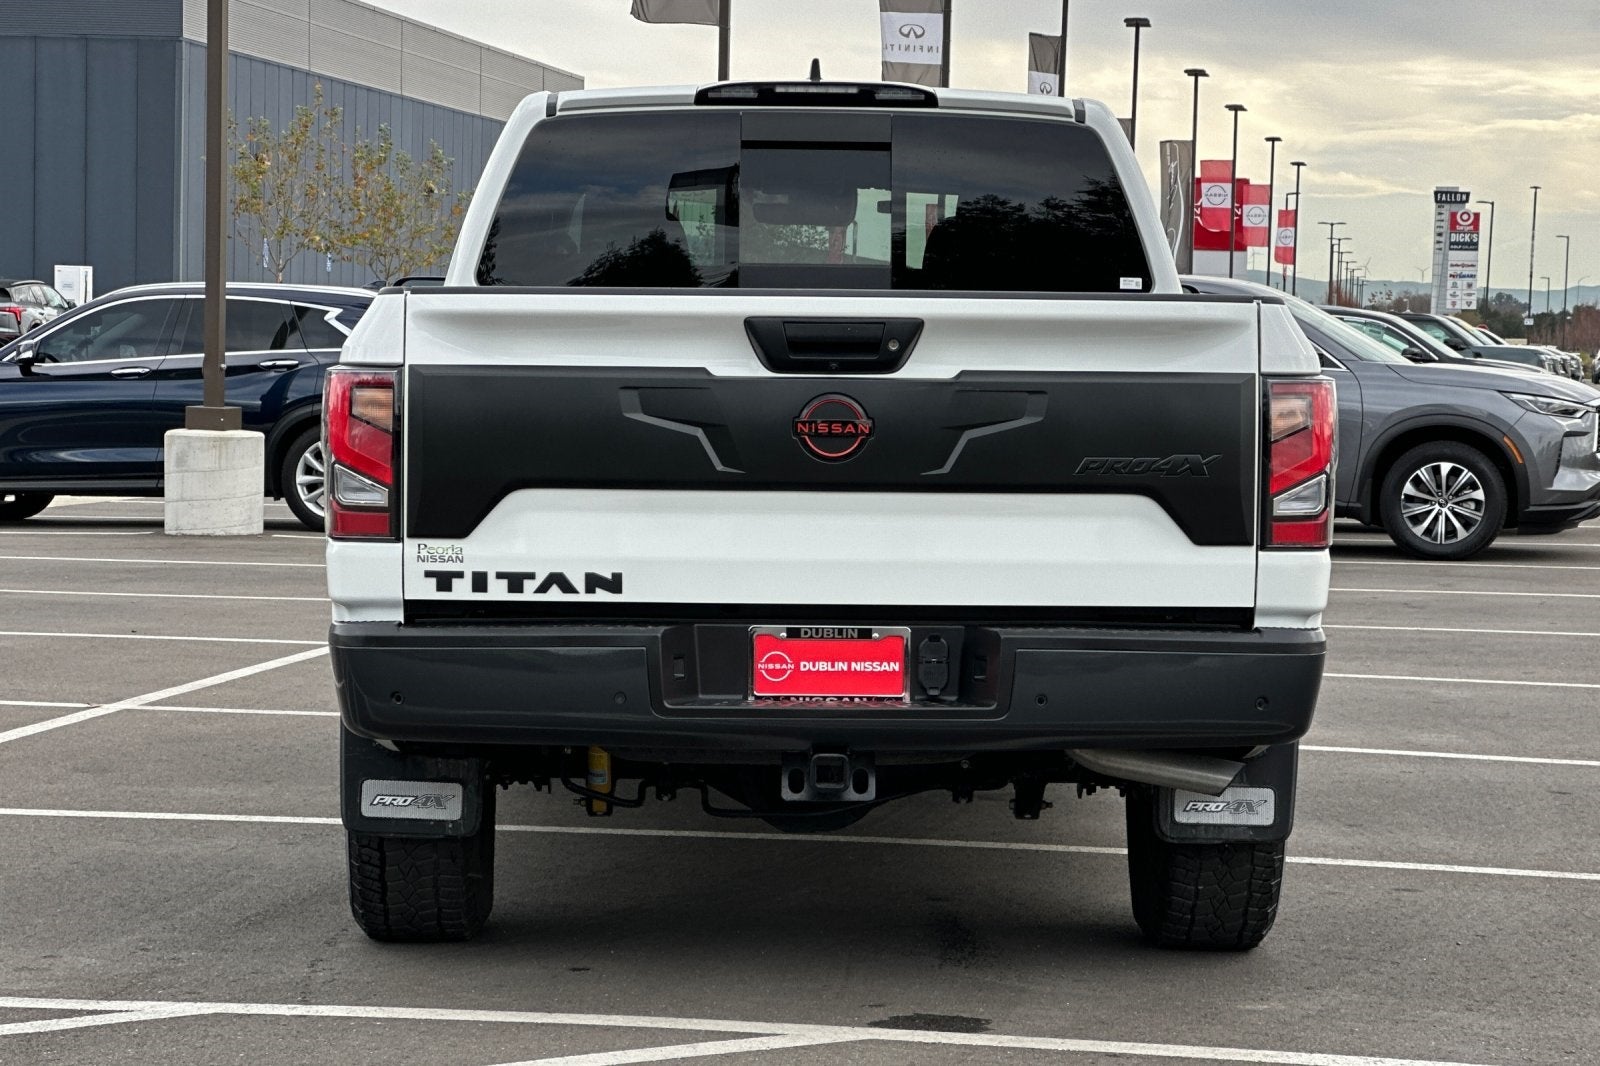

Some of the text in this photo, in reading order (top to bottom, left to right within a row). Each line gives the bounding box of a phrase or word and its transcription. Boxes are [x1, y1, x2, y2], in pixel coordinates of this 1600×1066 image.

[1437, 193, 1467, 202] FALLON
[1450, 233, 1479, 243] DICK'S
[797, 422, 870, 434] NISSAN
[417, 543, 463, 555] Peoria
[417, 555, 464, 564] NISSAN
[424, 570, 623, 594] TITAN
[800, 628, 858, 639] DUBLIN
[800, 662, 900, 672] DUBLIN NISSAN
